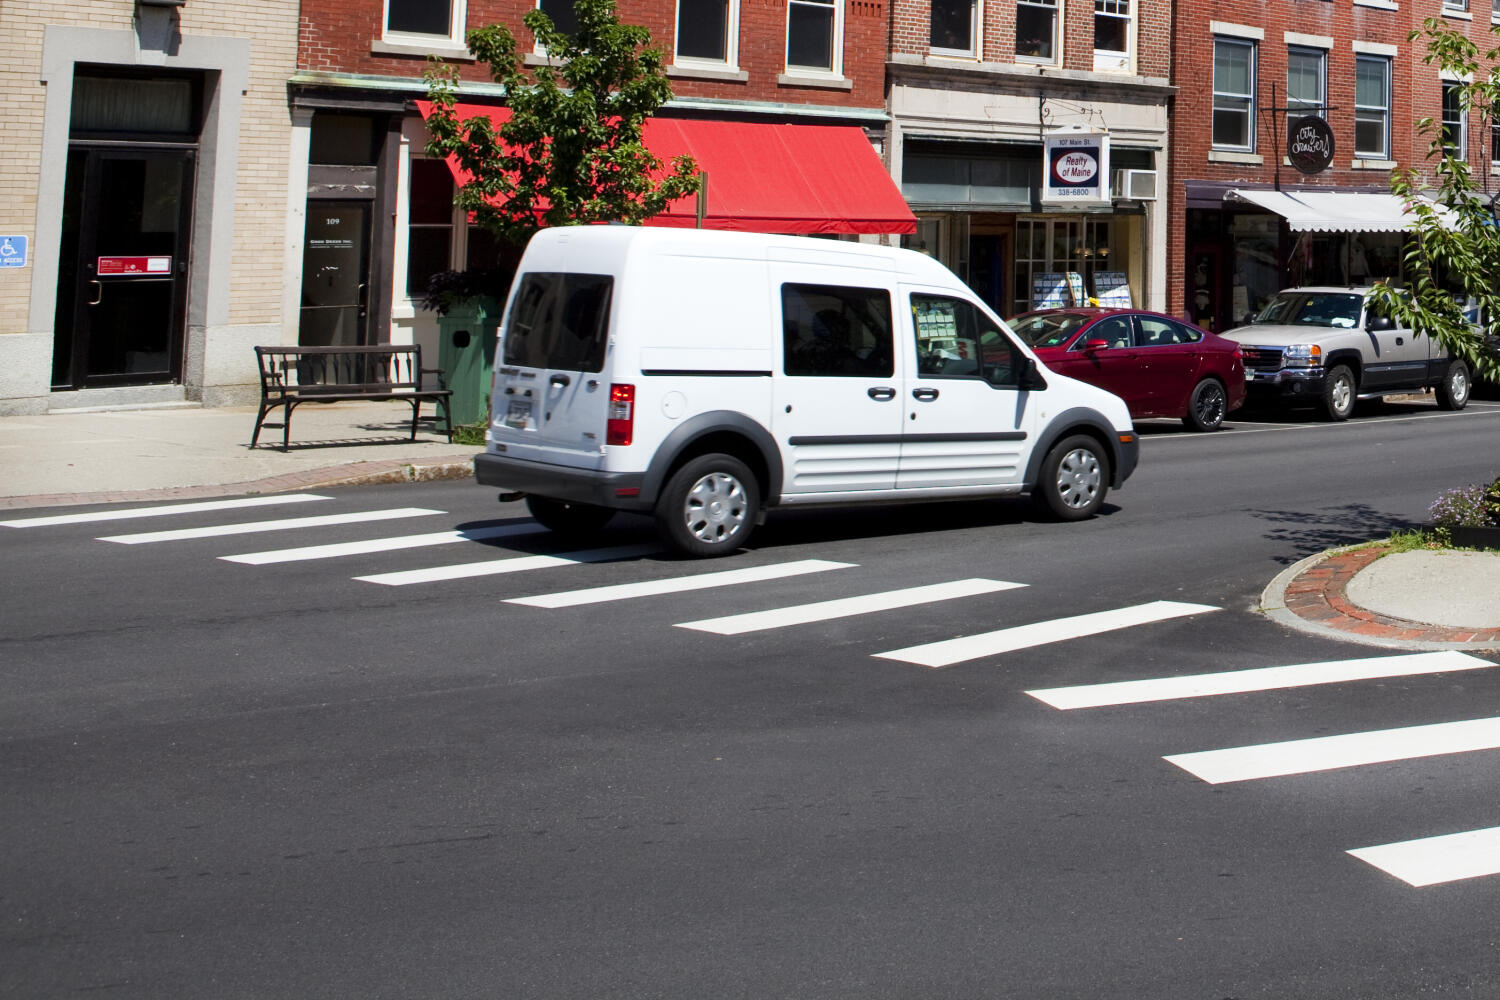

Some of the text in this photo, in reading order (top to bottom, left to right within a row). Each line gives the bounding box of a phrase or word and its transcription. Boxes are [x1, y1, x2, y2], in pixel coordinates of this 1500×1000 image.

[1300, 126, 1320, 145] City
[1066, 156, 1088, 167] Realty
[1062, 167, 1091, 177] of Maine
